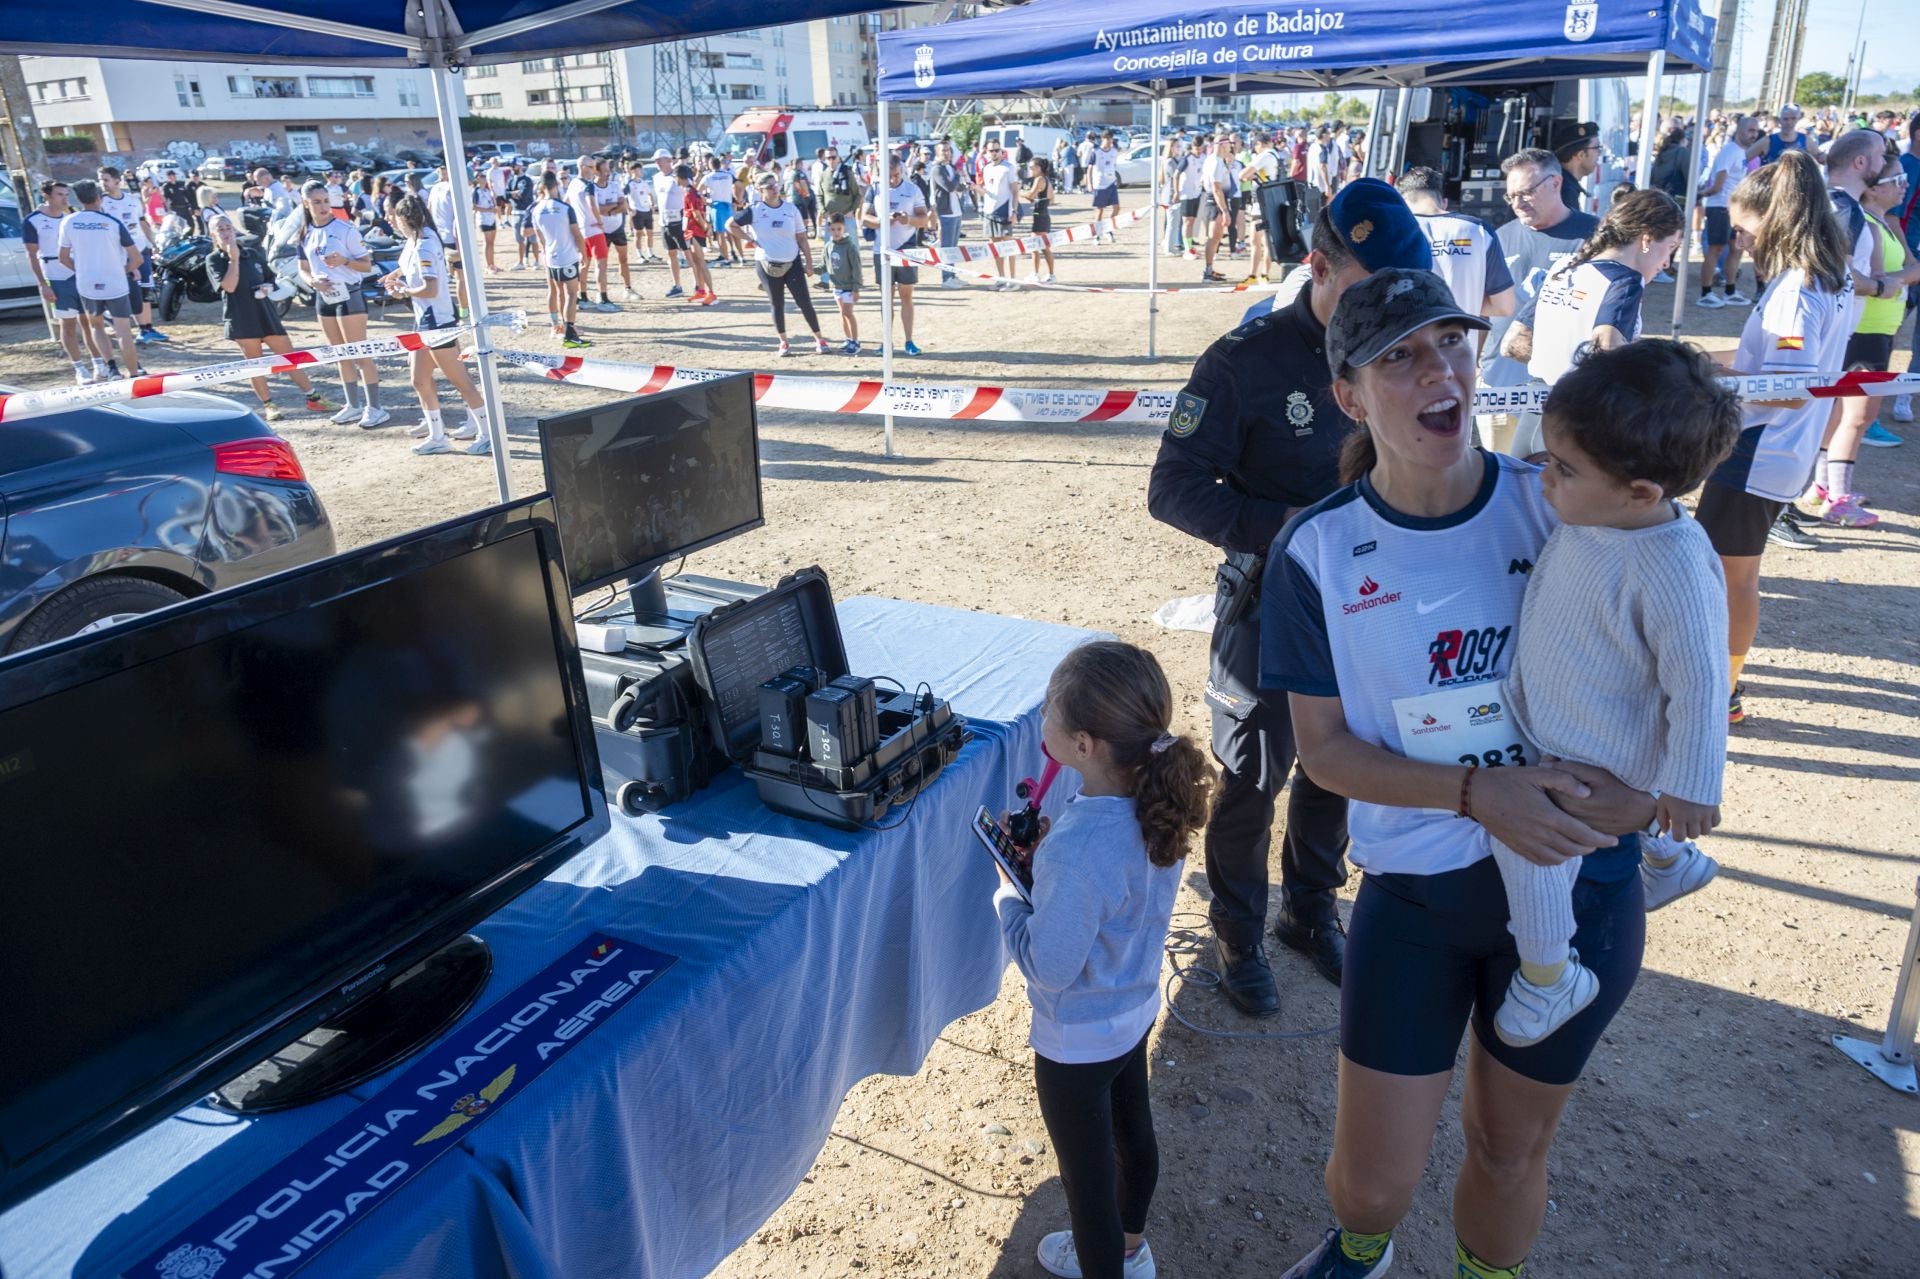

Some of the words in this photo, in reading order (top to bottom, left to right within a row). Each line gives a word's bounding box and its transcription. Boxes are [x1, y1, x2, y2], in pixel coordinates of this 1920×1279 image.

[1094, 19, 1227, 51] Ayuntamiento
[1234, 15, 1259, 37] de
[1266, 8, 1345, 35] Badajoz
[1113, 48, 1208, 72] Concejalía
[1213, 47, 1237, 64] de
[1243, 43, 1314, 62] Cultura
[361, 343, 373, 355] DE
[884, 386, 912, 398] POLICIA
[914, 387, 925, 399] DE
[927, 388, 950, 400] LINEA
[1472, 392, 1507, 407] POLIC
[1510, 391, 1528, 406] DE
[1137, 395, 1172, 408] POLICIA
[1342, 591, 1403, 616] Santander
[1411, 723, 1452, 736] Santander
[341, 962, 386, 996] Panasonic
[213, 1108, 418, 1251] POLICÍA
[416, 948, 622, 1101] NACIONAL
[243, 1159, 410, 1279] NIDAD
[535, 968, 654, 1062] AÉREA
